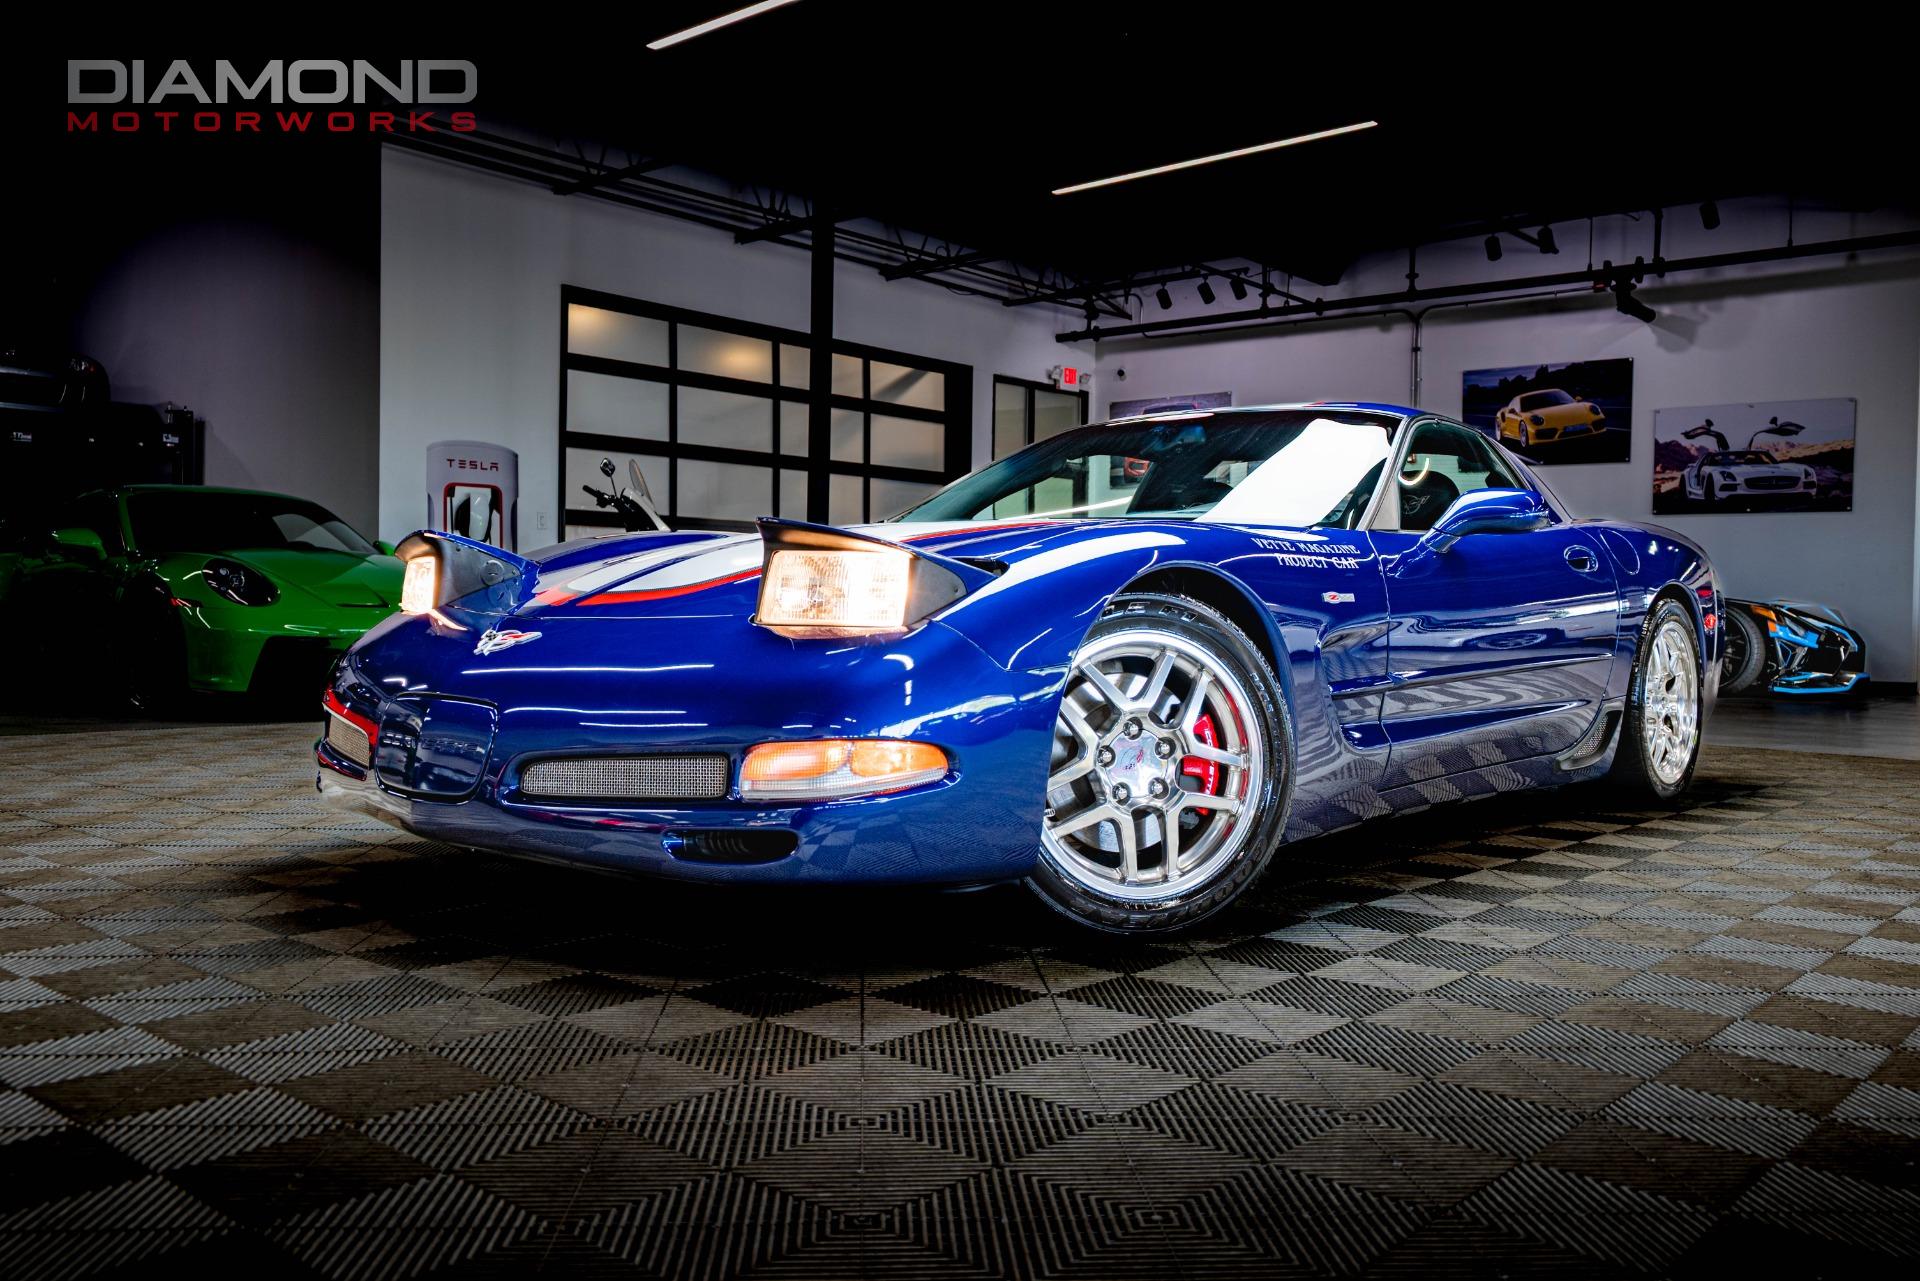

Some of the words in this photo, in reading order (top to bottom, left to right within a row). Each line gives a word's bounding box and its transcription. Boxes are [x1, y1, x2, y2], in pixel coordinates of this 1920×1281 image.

[446, 458, 499, 472] TESLA
[1250, 537, 1296, 552] VETTE
[1295, 542, 1361, 554] MAGAZINE
[1275, 553, 1328, 569] PROJECT
[1332, 556, 1360, 569] CAR
